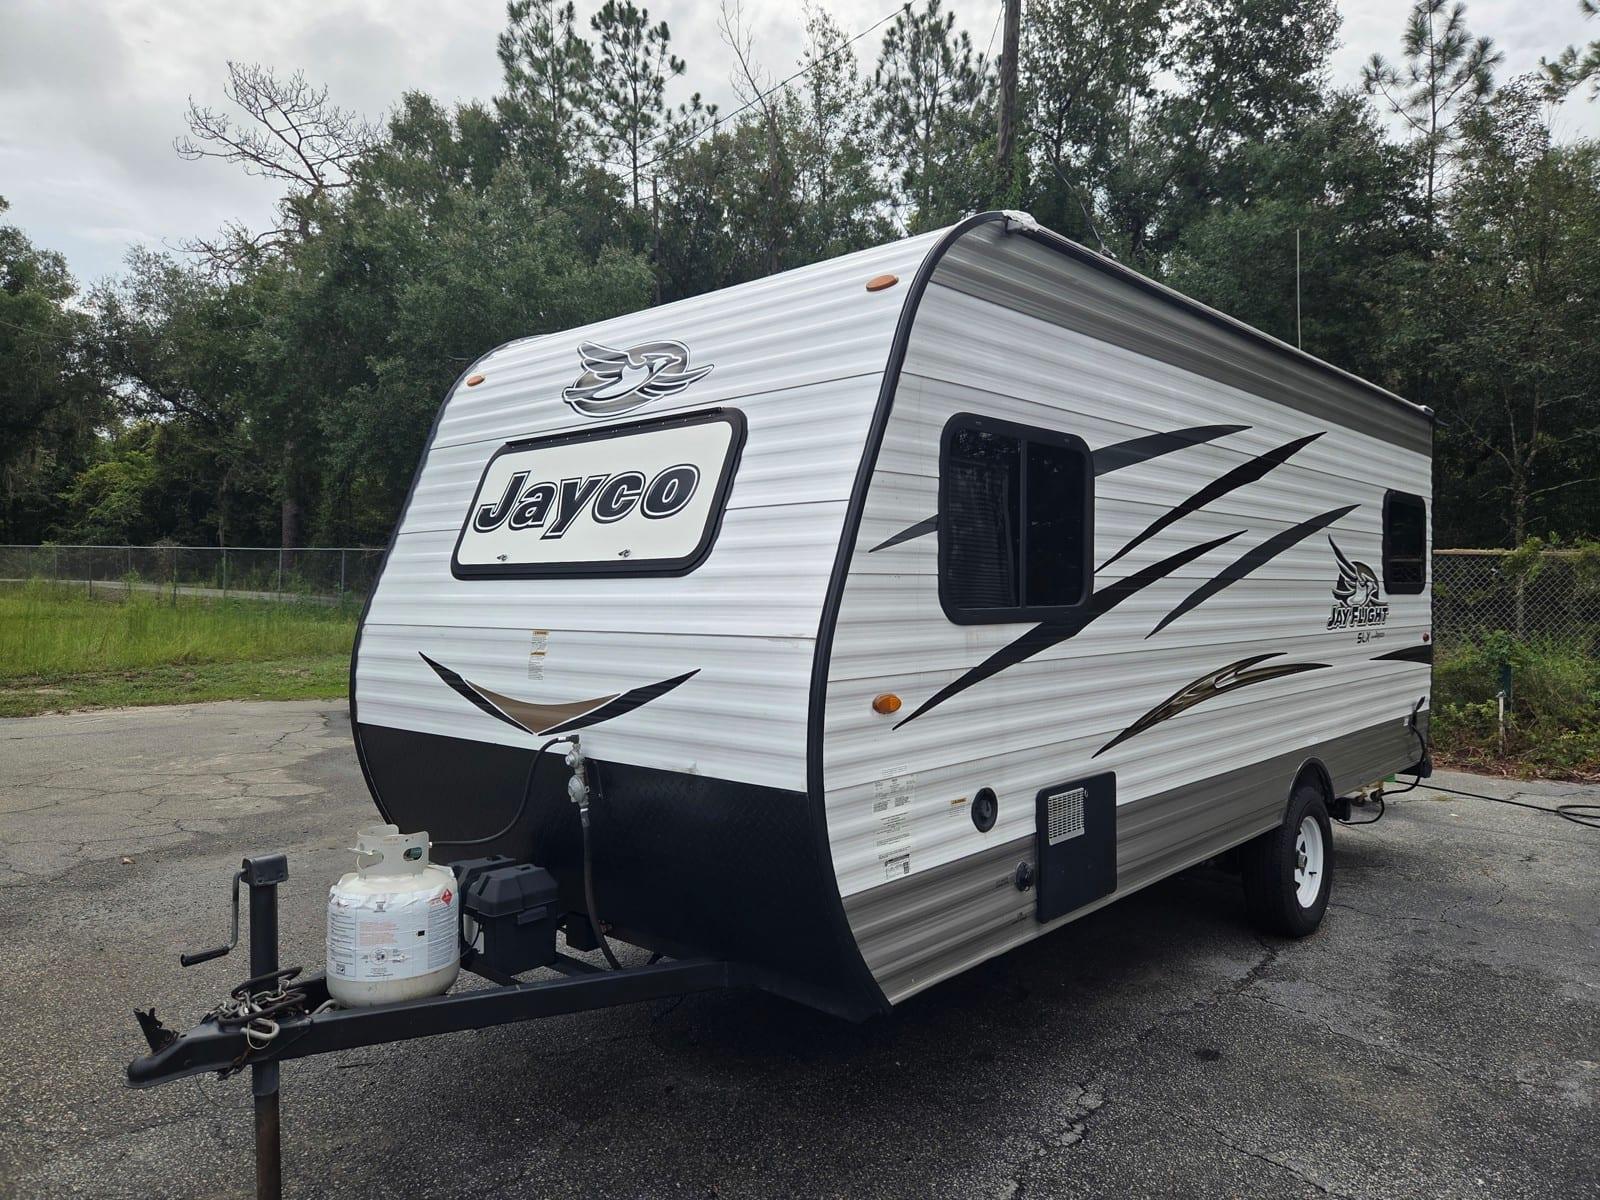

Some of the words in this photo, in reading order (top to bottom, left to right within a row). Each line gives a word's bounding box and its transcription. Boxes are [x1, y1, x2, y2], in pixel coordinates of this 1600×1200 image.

[473, 463, 701, 540] Jayco
[1327, 604, 1351, 630] JAY
[1350, 603, 1390, 626] FLIGHT
[1357, 631, 1370, 644] SLX
